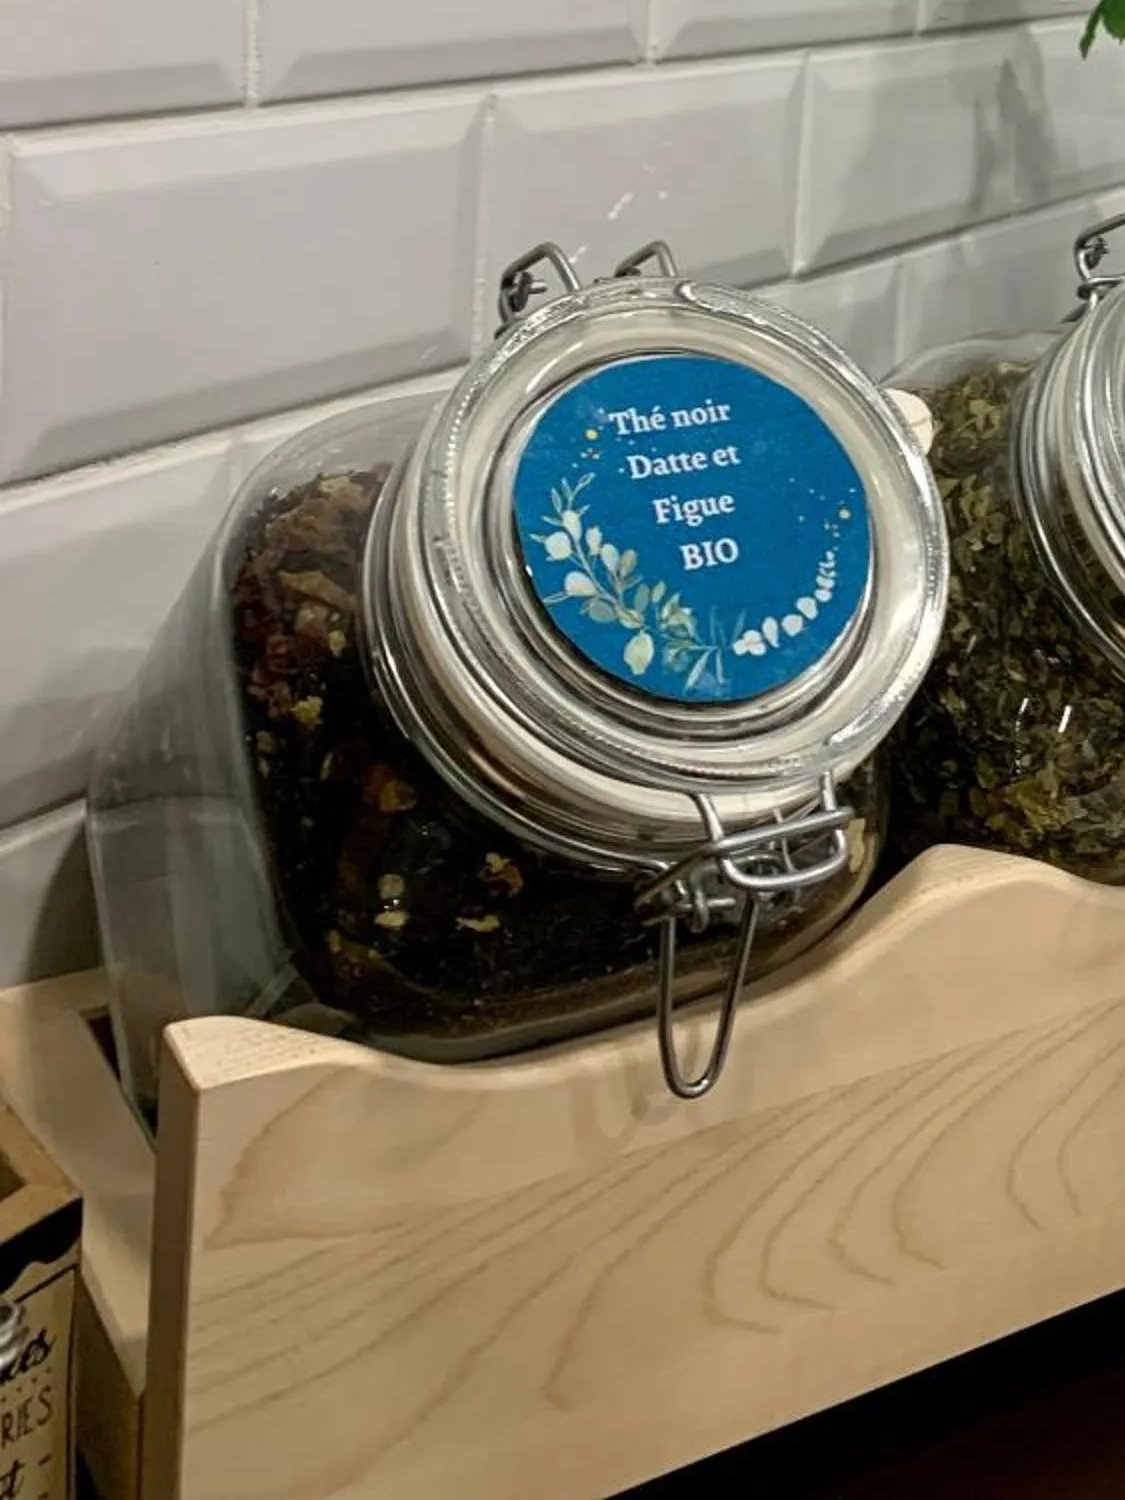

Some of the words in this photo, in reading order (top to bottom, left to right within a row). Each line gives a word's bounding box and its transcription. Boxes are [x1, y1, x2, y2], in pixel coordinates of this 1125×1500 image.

[608, 405, 665, 436] Thé
[672, 399, 732, 428] noir
[628, 452, 708, 479] Datte
[712, 445, 741, 468] et
[653, 495, 735, 527] Figue
[680, 538, 739, 571] BIO
